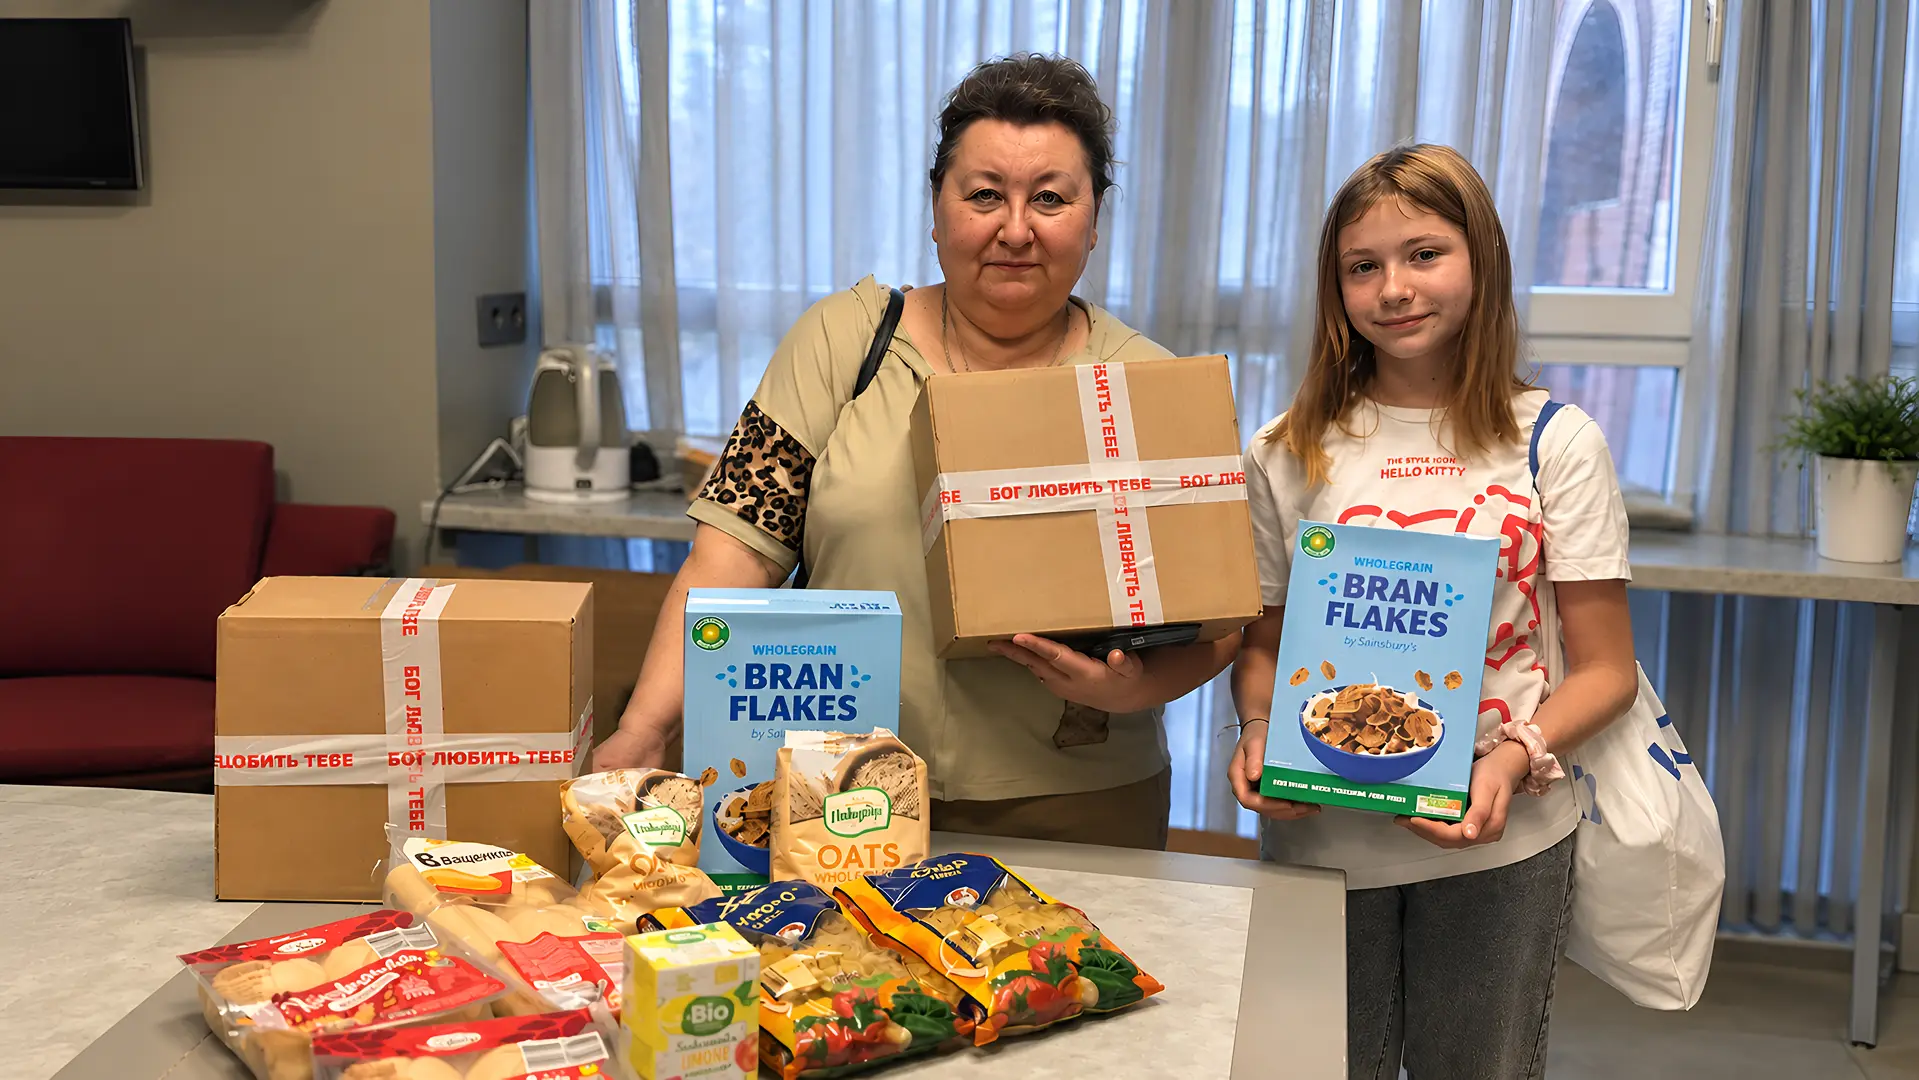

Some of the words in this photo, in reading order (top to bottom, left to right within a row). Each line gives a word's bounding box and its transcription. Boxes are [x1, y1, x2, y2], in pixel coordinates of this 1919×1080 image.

[1101, 415, 1120, 458] ТЕБЕ
[1380, 466, 1422, 479] HELLO
[1425, 466, 1466, 477] KITTY
[1387, 457, 1403, 465] THE
[989, 486, 1022, 501] БОГ
[1027, 481, 1103, 498] ЛЮБИТЬ
[1107, 478, 1152, 492] ТЕБЕ
[1179, 473, 1213, 488] БОГ
[1354, 556, 1433, 573] WHOLEGRAIN
[1343, 572, 1439, 607] BRAN
[1325, 600, 1449, 638] FLAKES
[752, 645, 837, 656] WHOLEGRAIN
[1344, 635, 1356, 648] by
[1358, 636, 1417, 653] Sainsbury's
[404, 665, 420, 700] БОГ
[744, 663, 843, 690] BRAN
[729, 694, 858, 722] FLAKES
[751, 728, 765, 741] by
[388, 751, 426, 767] БОГ
[432, 751, 520, 766] ЛЮБИТЬ
[526, 750, 574, 764] ТЕБЕ
[408, 787, 425, 831] ТЕБЕ
[817, 843, 901, 869] OATS
[691, 1002, 729, 1024] Bio
